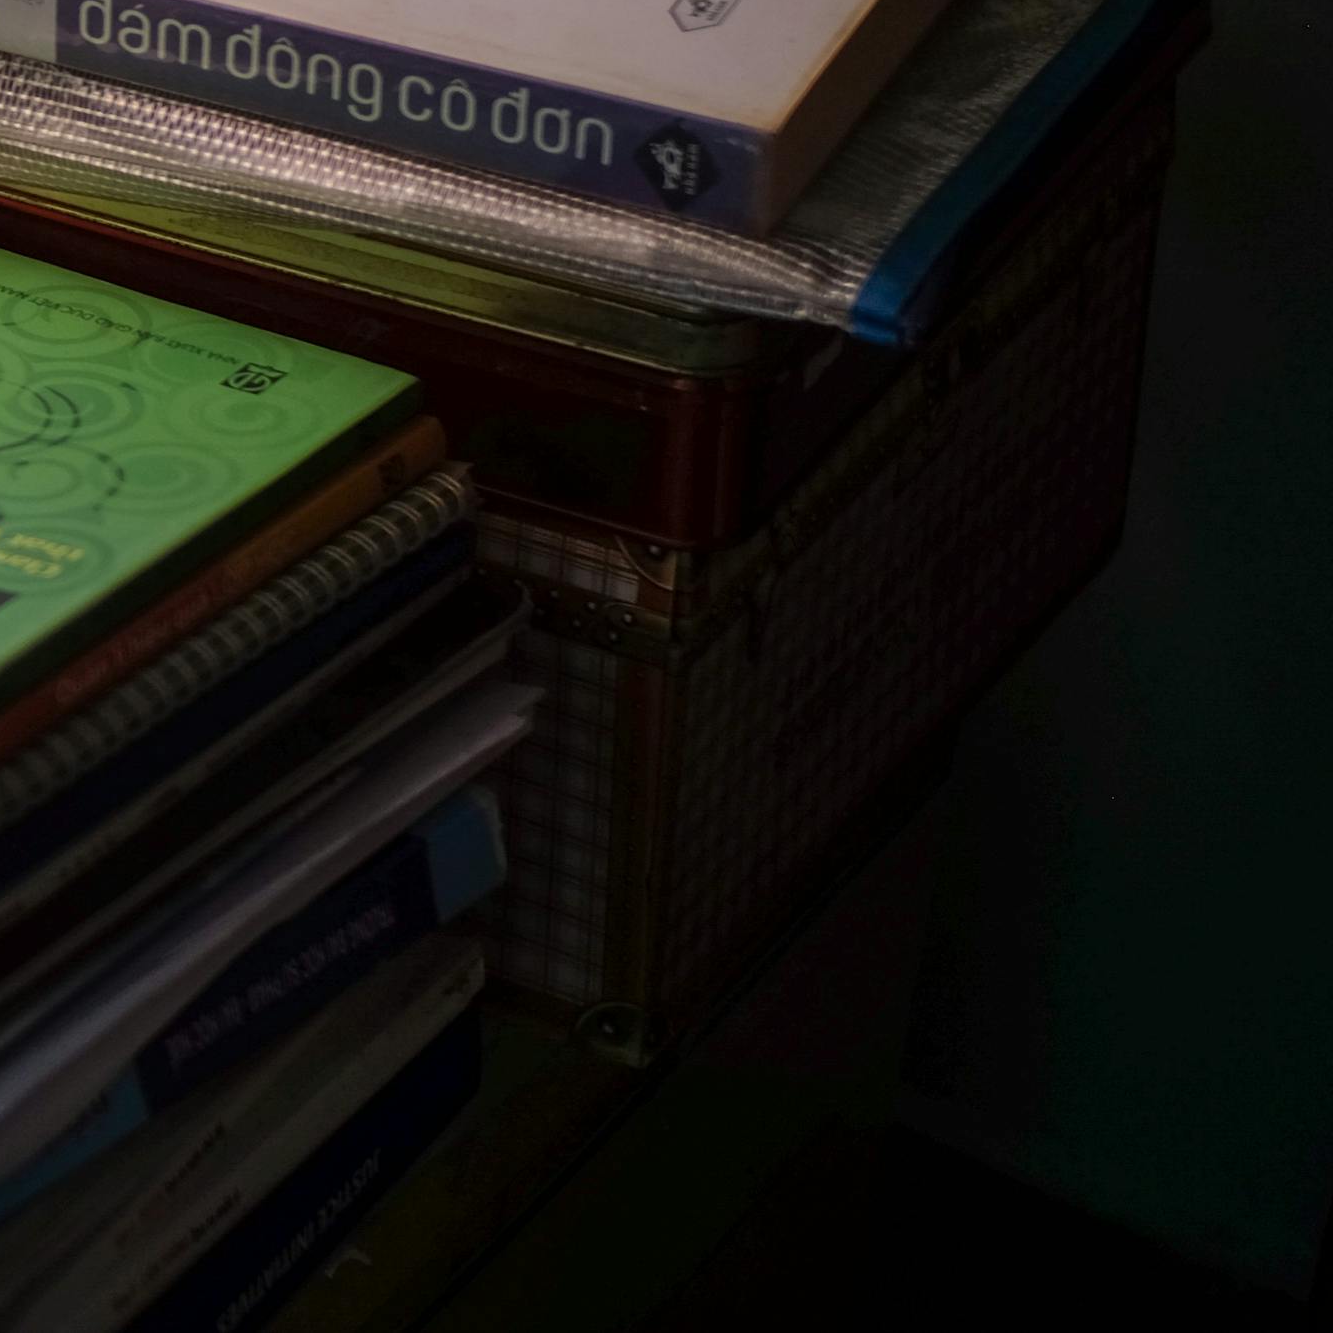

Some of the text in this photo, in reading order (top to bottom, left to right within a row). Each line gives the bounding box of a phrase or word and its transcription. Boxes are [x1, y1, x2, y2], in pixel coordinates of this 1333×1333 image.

[225, 18, 384, 123] đông
[398, 74, 478, 132] cô
[491, 87, 614, 166] đơn
